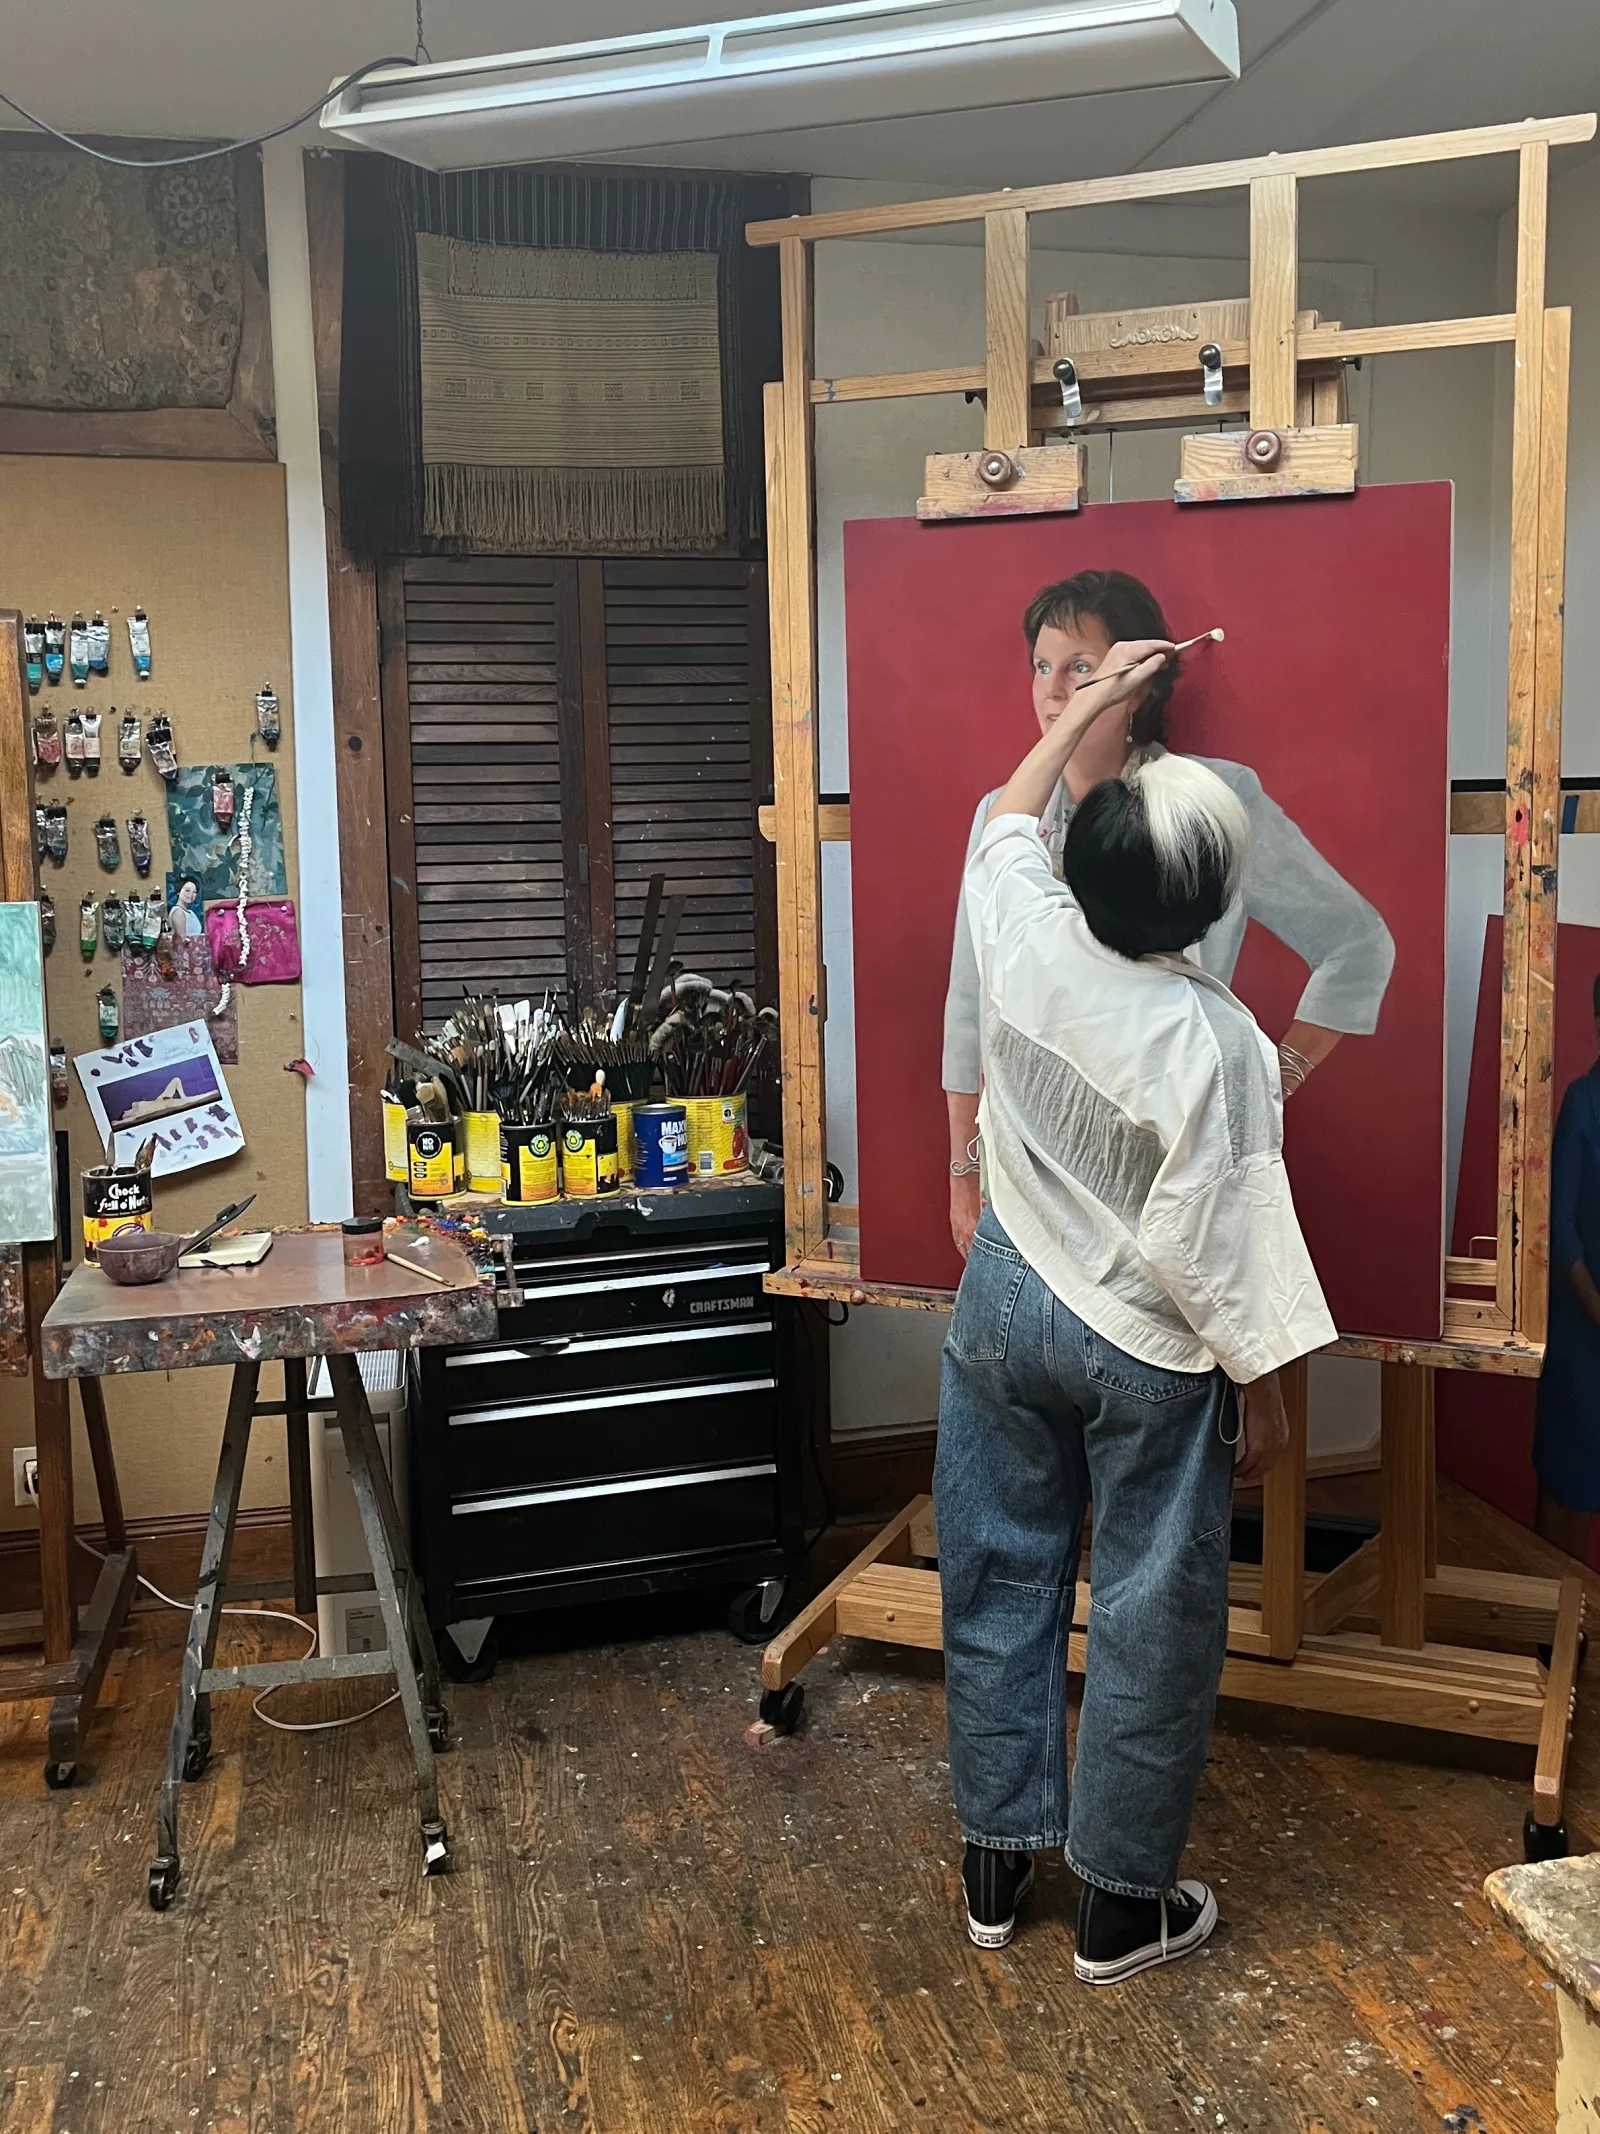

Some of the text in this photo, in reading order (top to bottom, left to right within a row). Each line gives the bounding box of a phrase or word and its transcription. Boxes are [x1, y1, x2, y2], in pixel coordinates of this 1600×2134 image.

[108, 1183, 140, 1200] Chock
[97, 1197, 119, 1213] full
[690, 1296, 754, 1314] CRAFTSMAN
